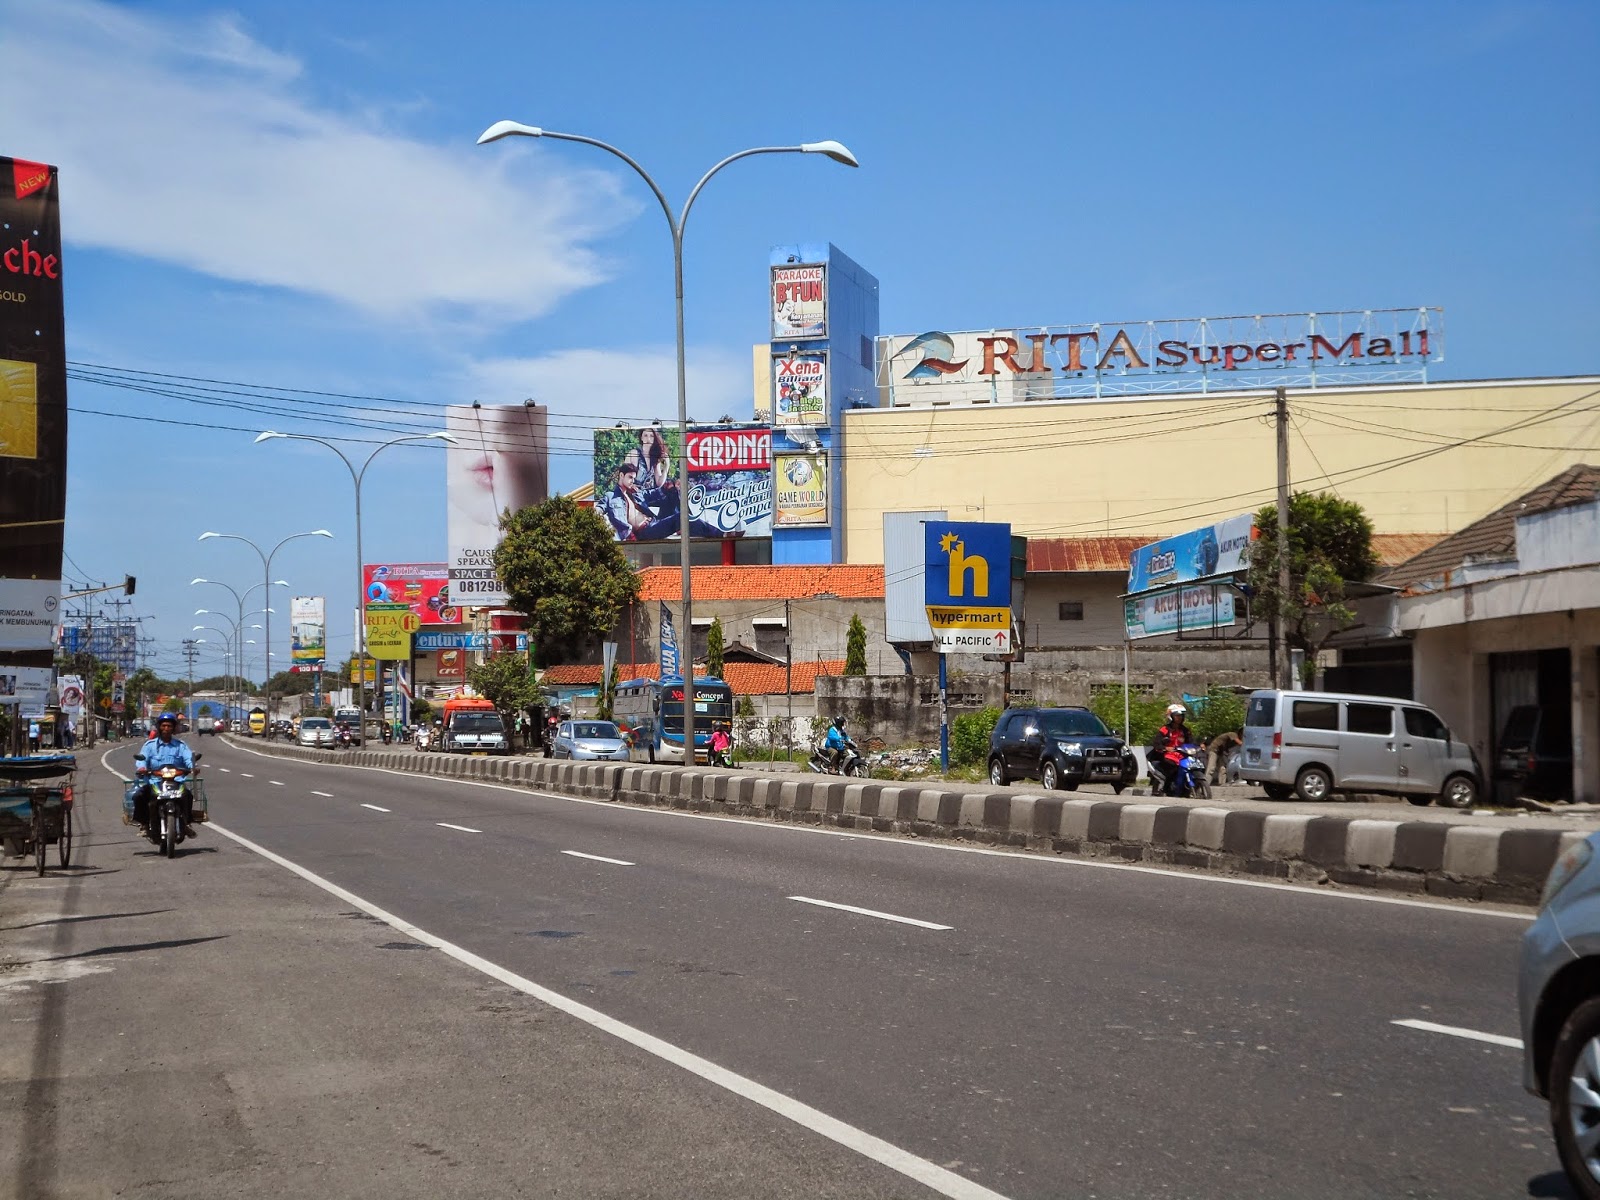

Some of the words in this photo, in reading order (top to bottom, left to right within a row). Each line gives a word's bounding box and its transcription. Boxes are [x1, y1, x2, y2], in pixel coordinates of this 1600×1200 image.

[19, 172, 46, 191] NEW
[0, 239, 58, 279] che
[776, 269, 821, 281] KARAOKE
[776, 281, 822, 303] B'FUN
[977, 329, 1149, 375] RITA
[780, 359, 820, 375] Xena
[777, 374, 823, 382] Billiard
[686, 434, 770, 467] CARDINA
[778, 491, 797, 503] GAME
[799, 490, 824, 502] WORLD
[454, 569, 487, 579] SPACE
[367, 615, 398, 626] RITA
[932, 611, 1003, 625] hypermart
[956, 636, 992, 646] PACIFIC
